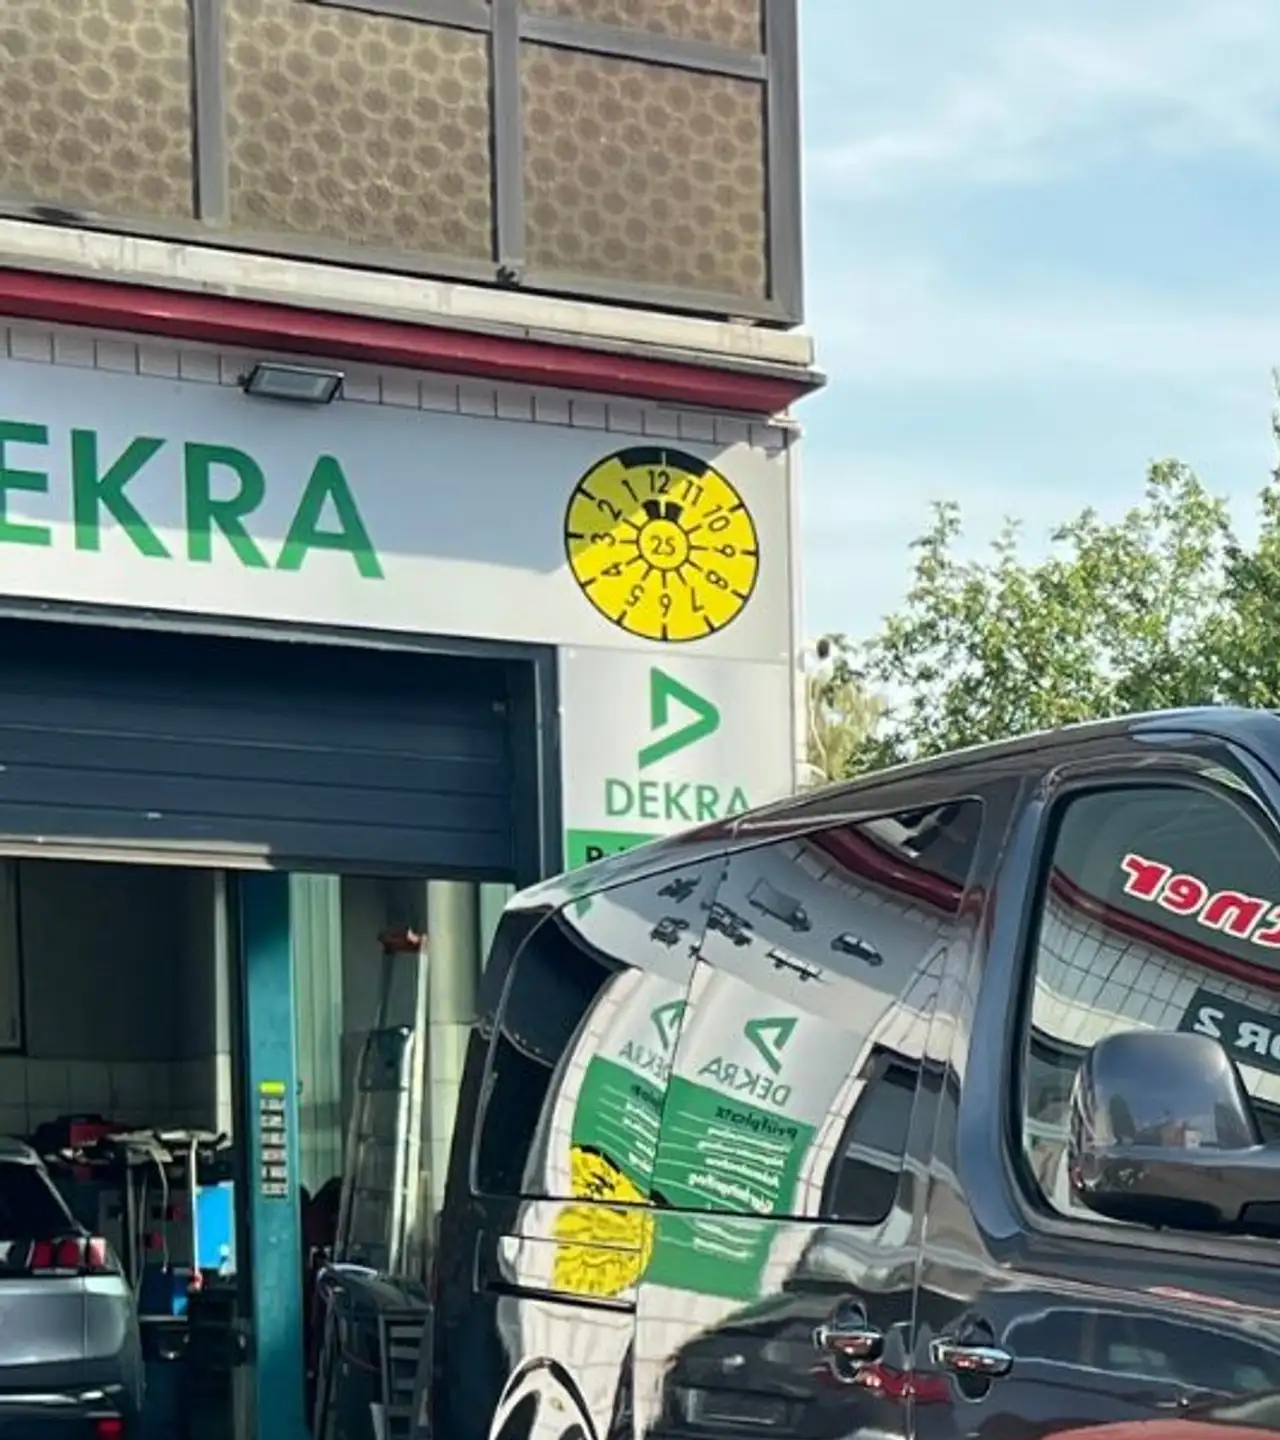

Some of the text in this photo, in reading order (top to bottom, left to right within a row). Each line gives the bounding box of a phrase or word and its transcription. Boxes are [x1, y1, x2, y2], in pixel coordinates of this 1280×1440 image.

[648, 471, 671, 495] 12
[681, 480, 704, 505] 11
[0, 419, 385, 579] EKRA
[598, 498, 623, 521] 2
[703, 505, 731, 532] 10
[591, 532, 616, 548] 3
[650, 536, 676, 556] 25
[714, 545, 736, 558] 9
[601, 562, 623, 577] 4
[705, 570, 729, 590] 8
[626, 584, 645, 606] 5
[660, 594, 672, 617] 6
[691, 587, 704, 612] 7
[605, 778, 752, 822] DEKRA
